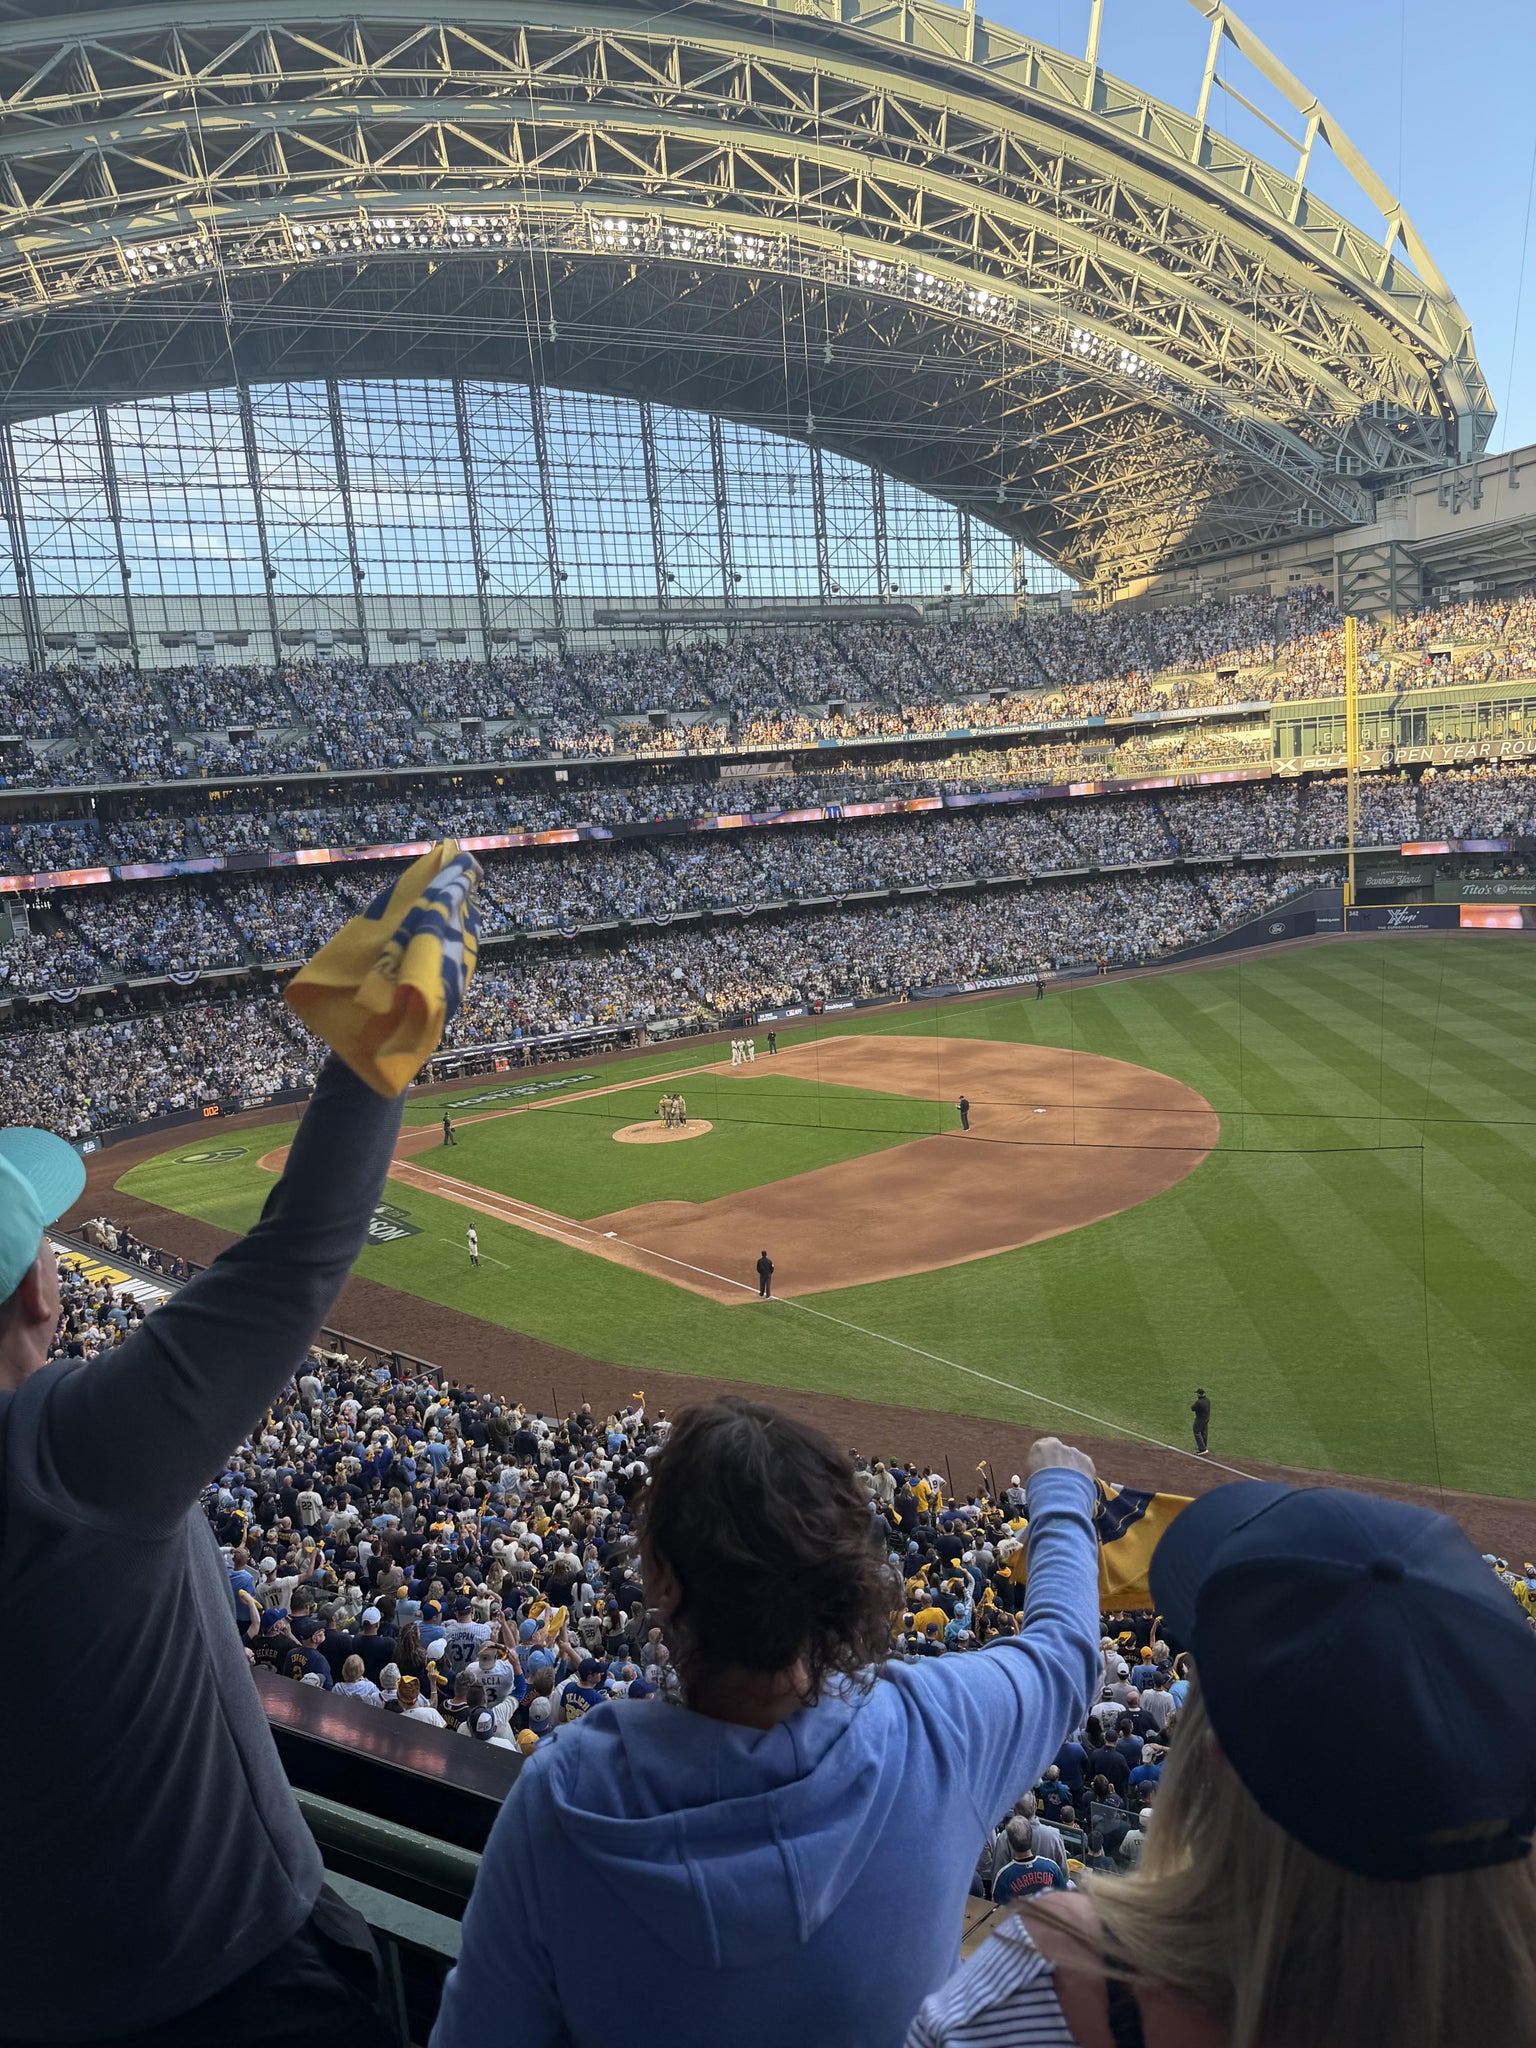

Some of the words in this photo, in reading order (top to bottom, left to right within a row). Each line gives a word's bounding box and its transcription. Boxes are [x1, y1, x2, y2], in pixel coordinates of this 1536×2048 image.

[1048, 721, 1073, 729] LEGENDS
[1074, 719, 1088, 727] CLUB
[909, 733, 932, 741] LEGENDS
[933, 731, 946, 739] CLUB
[979, 726, 1019, 736] Northwestern
[844, 737, 882, 746] Northwestern
[1381, 747, 1433, 765] OPEN
[1442, 743, 1491, 759] YEAR
[1274, 759, 1298, 773] X
[1365, 875, 1396, 886] Barrel
[1397, 874, 1421, 886] Yard
[1462, 884, 1492, 895] Tito's
[975, 972, 1038, 990] POSTSEASON
[825, 1002, 853, 1010] Booking.com
[203, 1106, 219, 1117] 002
[302, 1501, 312, 1511] 22
[270, 1594, 280, 1606] 11
[452, 1631, 475, 1641] SUPPAN
[451, 1643, 475, 1662] 37
[566, 1692, 591, 1711] YELICH
[1010, 1871, 1054, 1893] HARRISON
